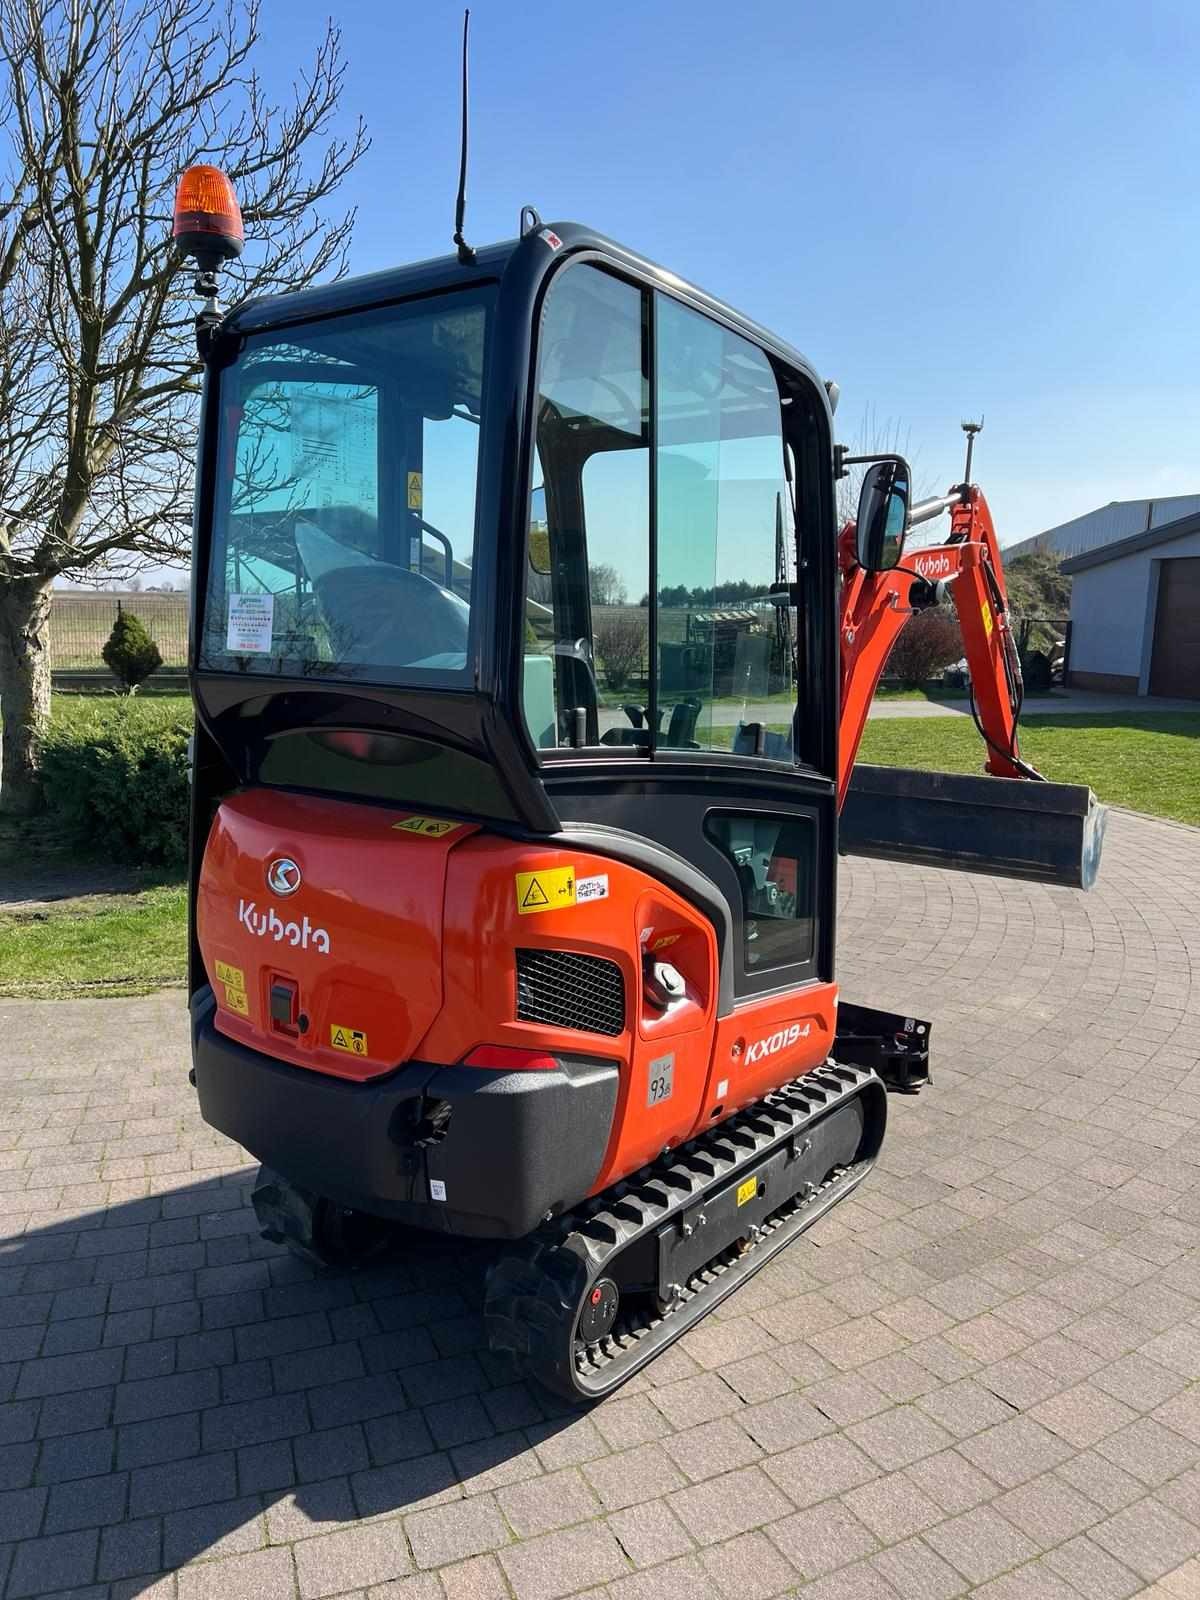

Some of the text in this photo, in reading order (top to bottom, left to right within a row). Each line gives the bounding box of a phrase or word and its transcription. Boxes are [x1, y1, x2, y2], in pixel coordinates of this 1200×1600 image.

[915, 554, 949, 576] Kubota
[238, 899, 330, 954] Kubota
[744, 1023, 811, 1067] KX019-4
[650, 1076, 665, 1103] 93
